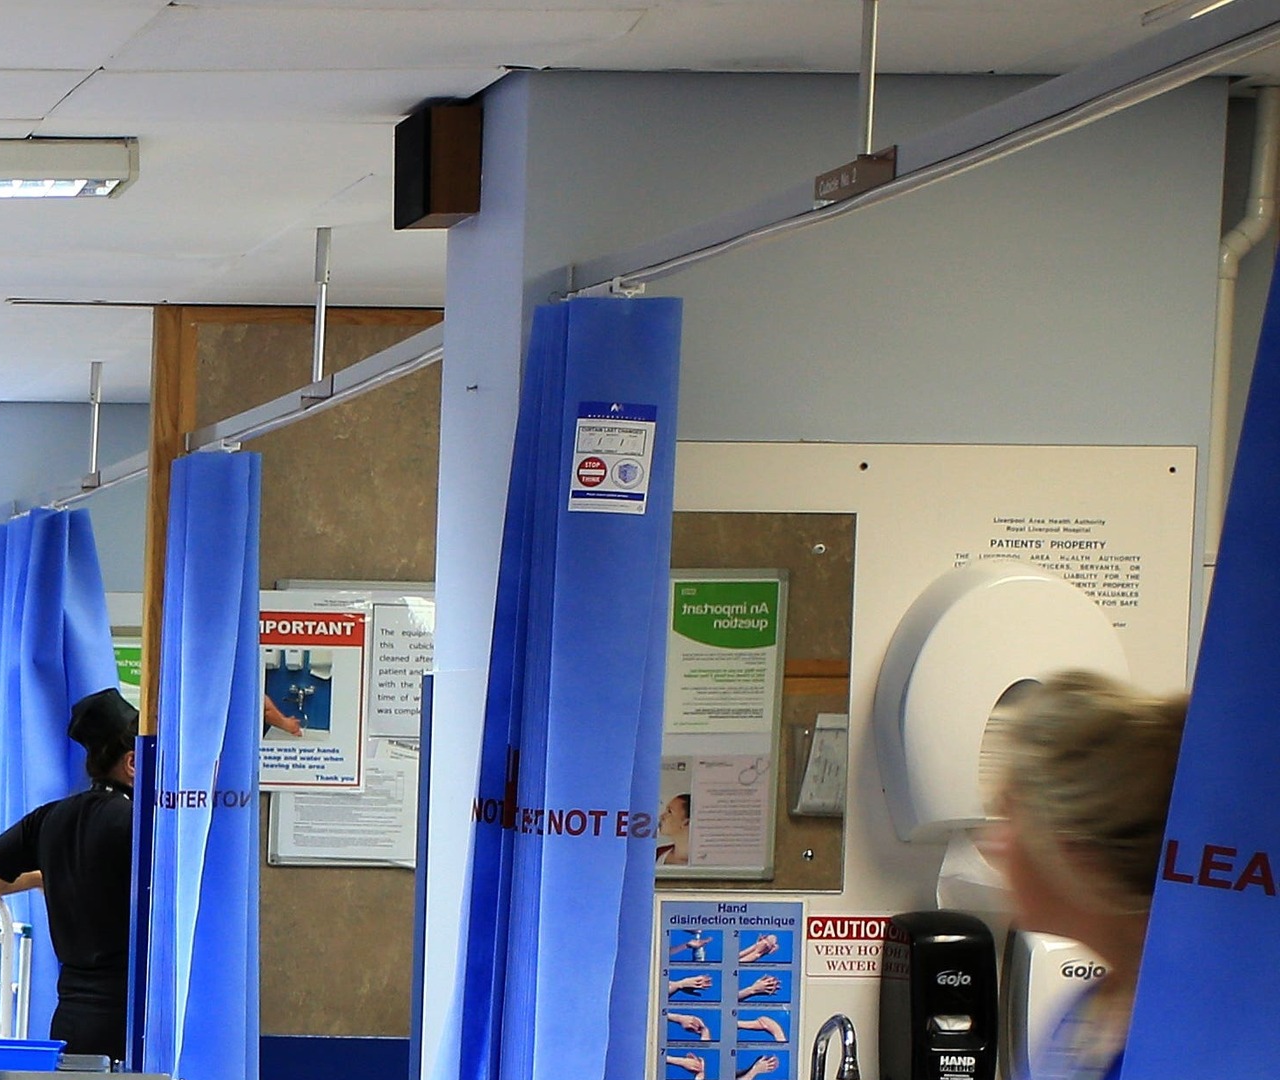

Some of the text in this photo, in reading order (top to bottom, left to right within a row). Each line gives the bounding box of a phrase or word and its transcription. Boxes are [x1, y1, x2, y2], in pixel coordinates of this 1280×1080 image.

[1074, 518, 1106, 526] Authority
[990, 539, 1107, 550] PATIENTS' PROPERTY
[260, 621, 355, 637] PORTANT
[381, 628, 394, 636] The
[380, 642, 394, 650] this
[379, 655, 434, 663] cleaned after
[379, 668, 406, 676] patient
[394, 707, 420, 715] compl
[263, 762, 289, 770] leaving
[548, 808, 608, 837] NOT
[1162, 839, 1277, 896] LEA
[718, 903, 747, 913] Hand
[670, 914, 795, 927] disinfection technique
[815, 945, 881, 956] VERY HO
[826, 960, 876, 971] WATER
[940, 1055, 976, 1066] HAND
